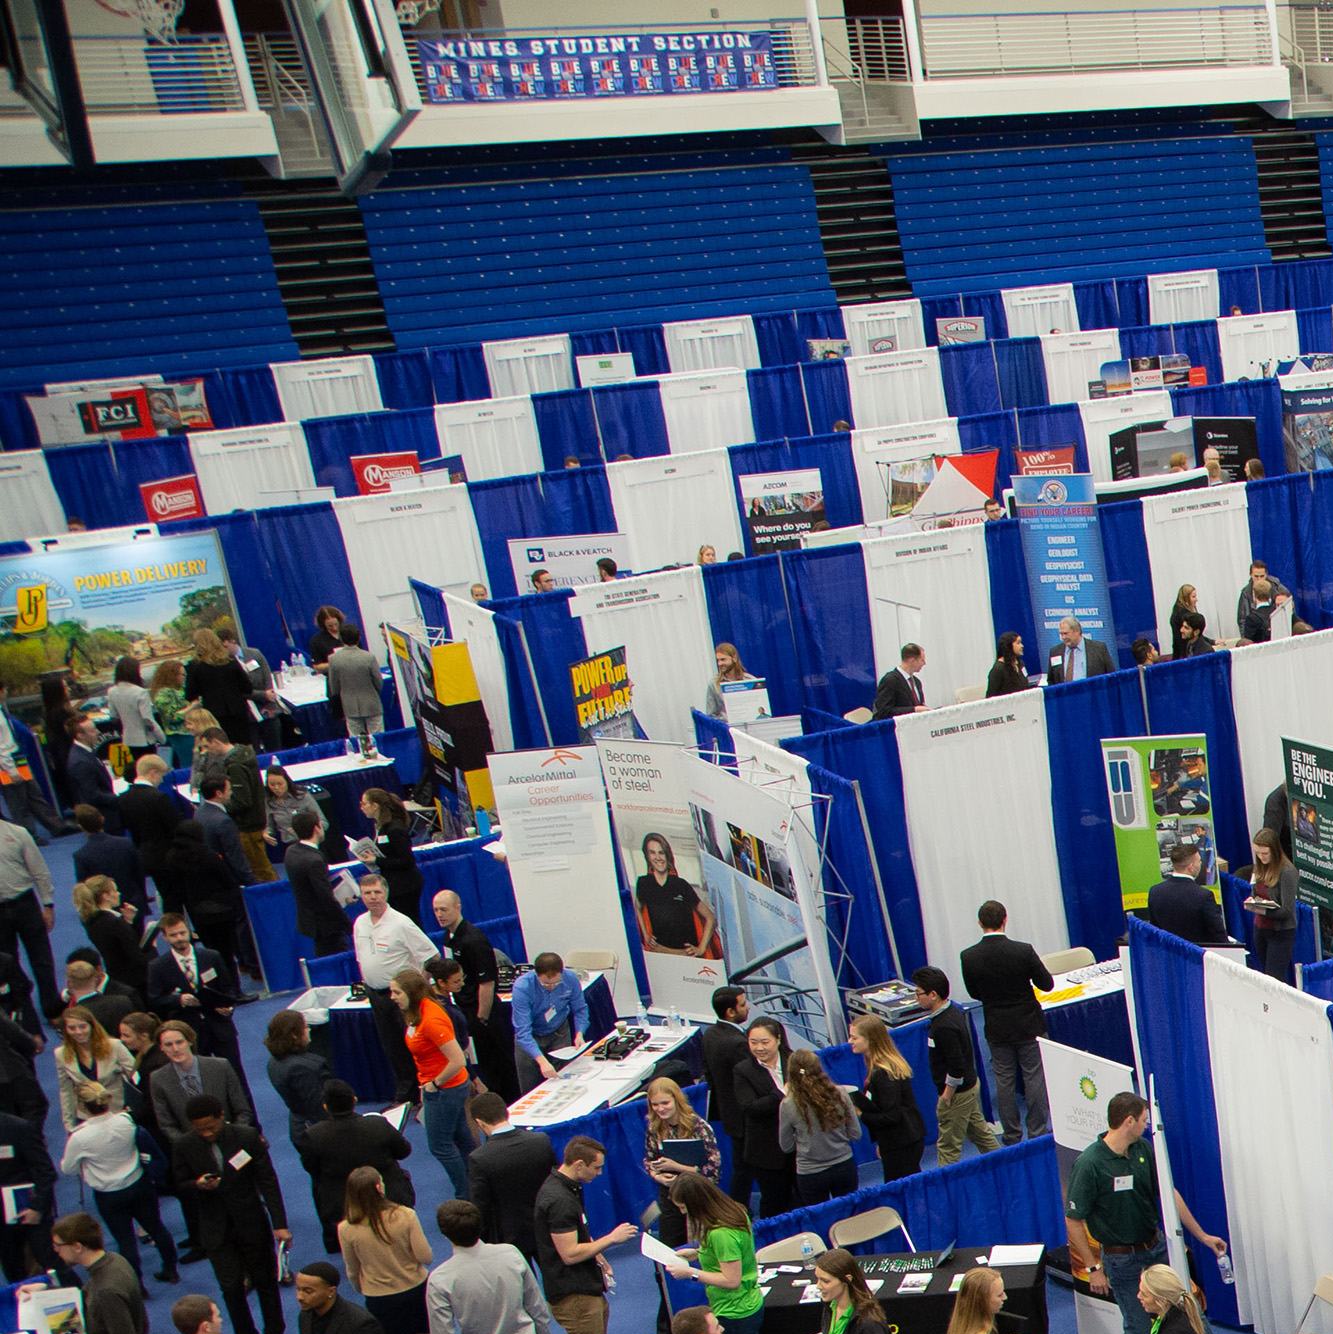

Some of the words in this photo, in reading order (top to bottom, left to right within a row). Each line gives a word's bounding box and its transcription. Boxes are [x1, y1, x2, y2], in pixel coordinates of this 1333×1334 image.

[437, 42, 518, 58] MINES
[531, 36, 641, 56] STUDENT
[653, 33, 752, 51] SECTION
[427, 63, 459, 78] BLUE
[510, 62, 541, 77] BLUE
[590, 59, 621, 74] BLUE
[667, 57, 698, 71] BLUE
[1300, 396, 1322, 406] Solving
[97, 404, 138, 422] FCI
[1022, 451, 1056, 466] 100%
[152, 492, 196, 515] MANSON
[752, 523, 779, 535] Where
[782, 523, 793, 532] do
[794, 521, 811, 532] you
[756, 534, 770, 544] see
[547, 548, 573, 558] BLACK
[73, 571, 131, 592] POWER
[134, 559, 208, 586] DELIVERY
[571, 655, 615, 697] POWER
[613, 664, 627, 682] UP
[930, 726, 959, 738] CALIFORNIA
[960, 723, 975, 733] STEEL
[606, 750, 650, 764] Become
[1291, 749, 1301, 761] BE
[1302, 751, 1317, 766] THE
[508, 770, 576, 784] ArcelorMittal
[621, 768, 661, 779] woman
[528, 785, 559, 794] Career
[612, 780, 621, 789] of
[626, 780, 655, 792] steel.
[1302, 779, 1326, 799] YOU.
[529, 793, 593, 805] Opportunities
